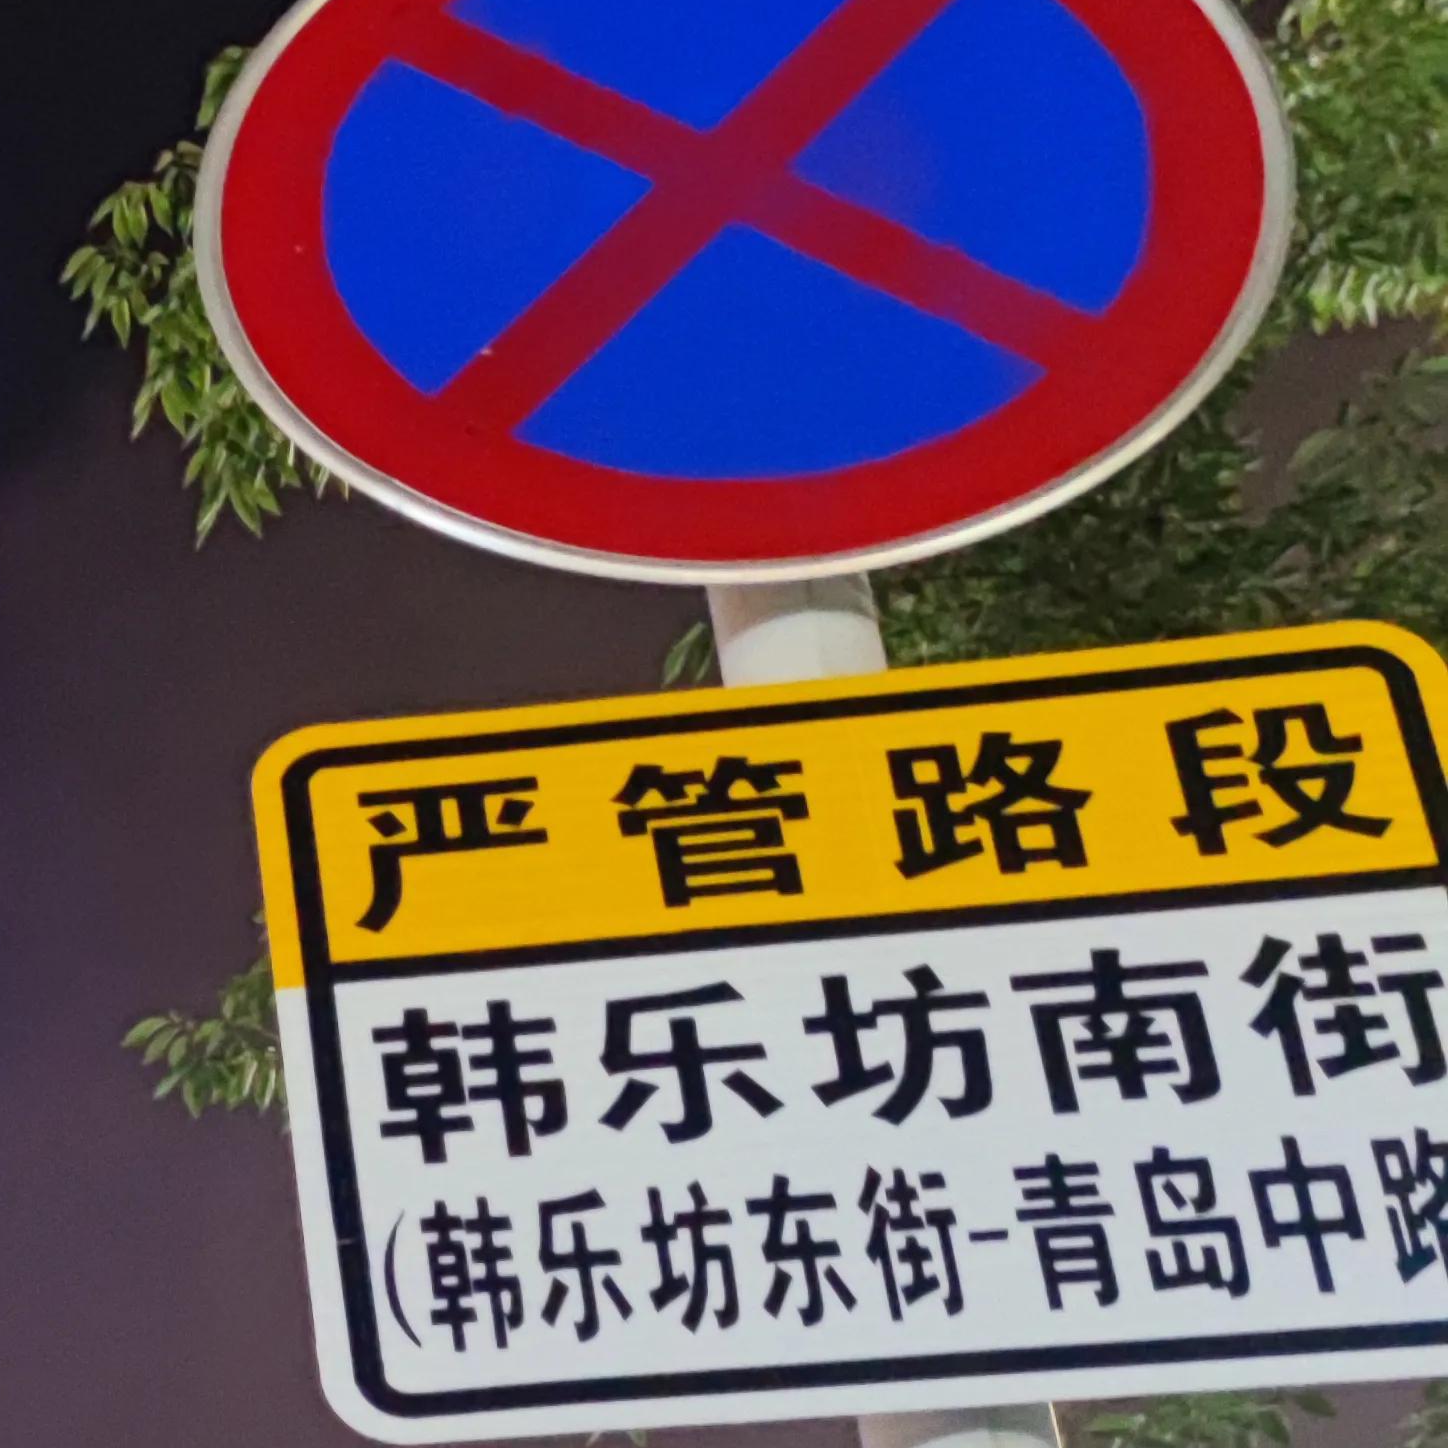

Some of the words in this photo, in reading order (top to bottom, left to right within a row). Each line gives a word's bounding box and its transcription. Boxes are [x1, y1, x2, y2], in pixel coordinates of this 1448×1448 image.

[356, 701, 1395, 933] 严管路段
[371, 933, 1448, 1164] 韩乐坊南街
